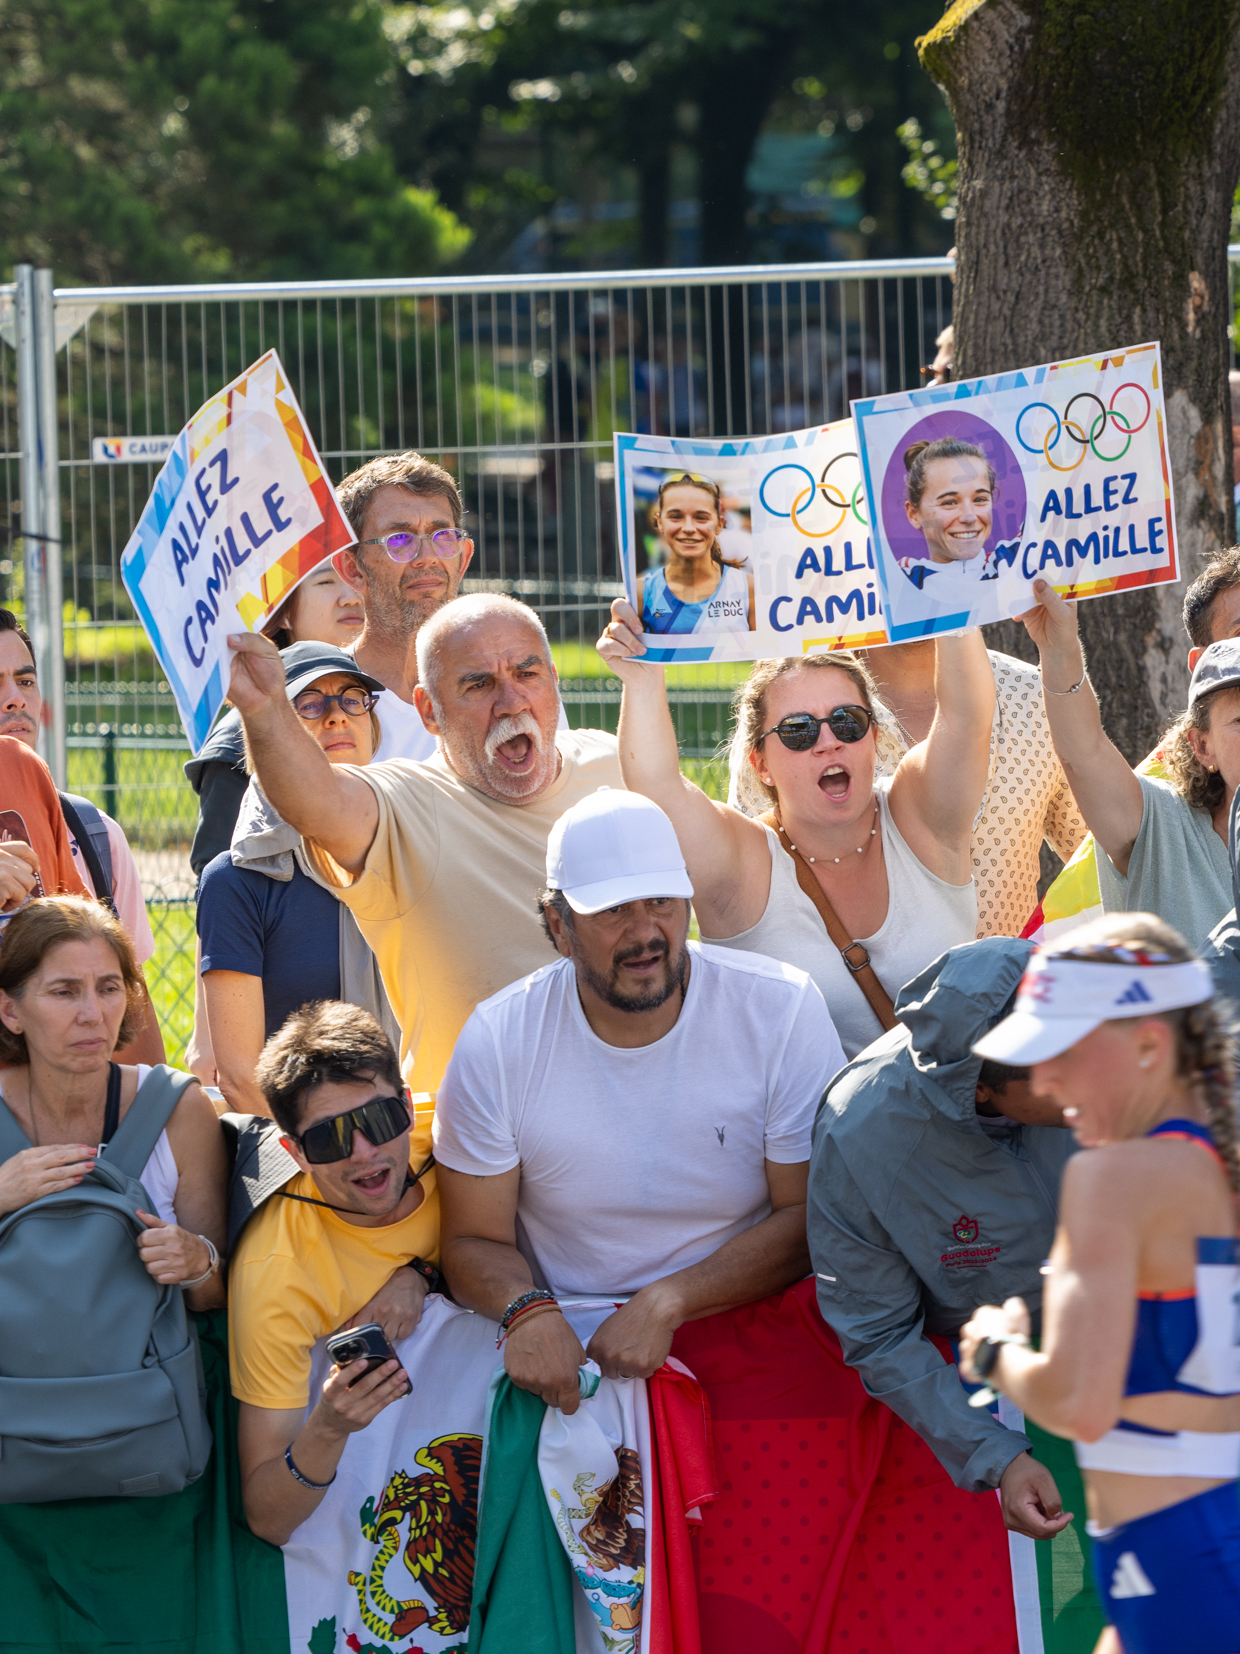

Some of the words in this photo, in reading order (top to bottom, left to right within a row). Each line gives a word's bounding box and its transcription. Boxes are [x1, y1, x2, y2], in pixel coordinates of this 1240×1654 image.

[128, 441, 174, 456] CAUP
[1040, 472, 1138, 523] ALLEZ
[171, 448, 240, 587] ALLEZ
[708, 599, 741, 609] ARNAY
[769, 582, 883, 632] CAMi
[708, 609, 720, 618] LE
[723, 608, 743, 617] DUC
[940, 1246, 1001, 1263] Guadalupe
